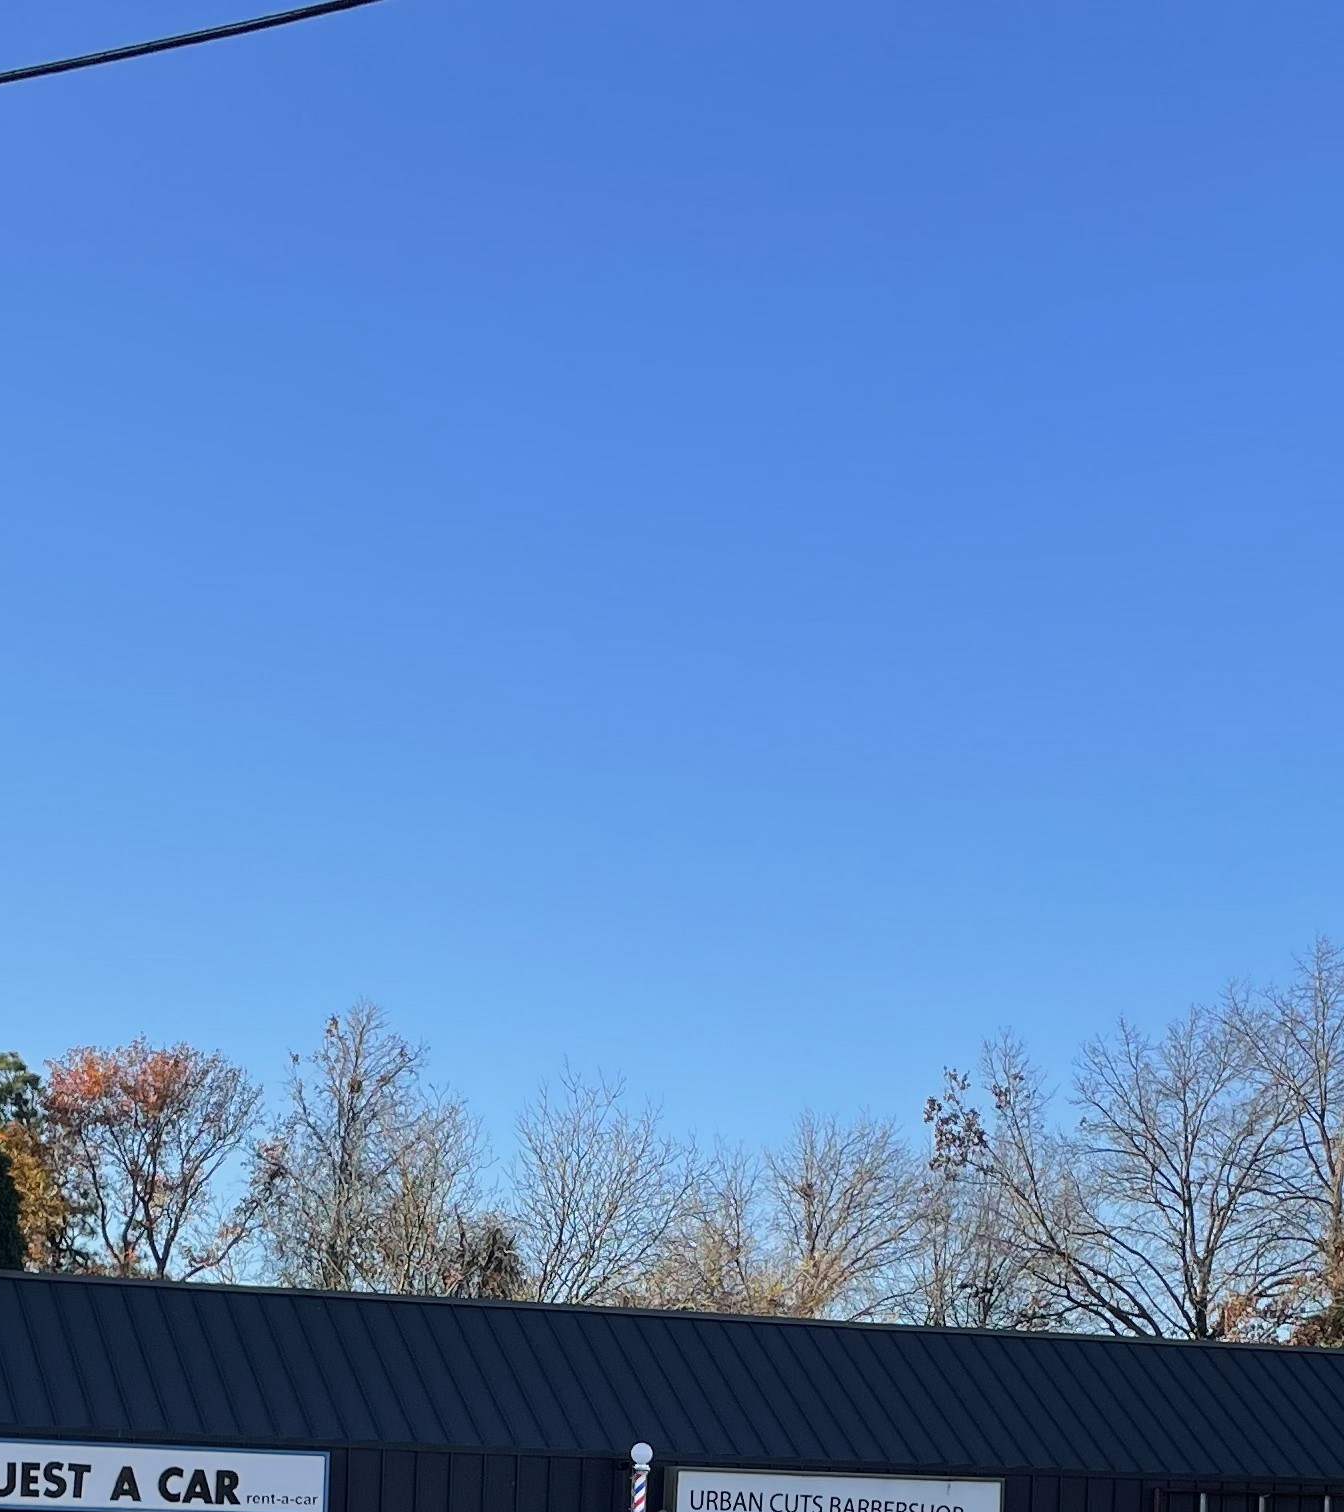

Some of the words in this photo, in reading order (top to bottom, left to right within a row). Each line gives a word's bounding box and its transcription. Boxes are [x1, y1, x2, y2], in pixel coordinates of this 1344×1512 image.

[110, 1465, 142, 1502] A
[158, 1466, 241, 1505] CAR
[246, 1494, 319, 1505] rent-a-car
[689, 1489, 763, 1512] URBAN
